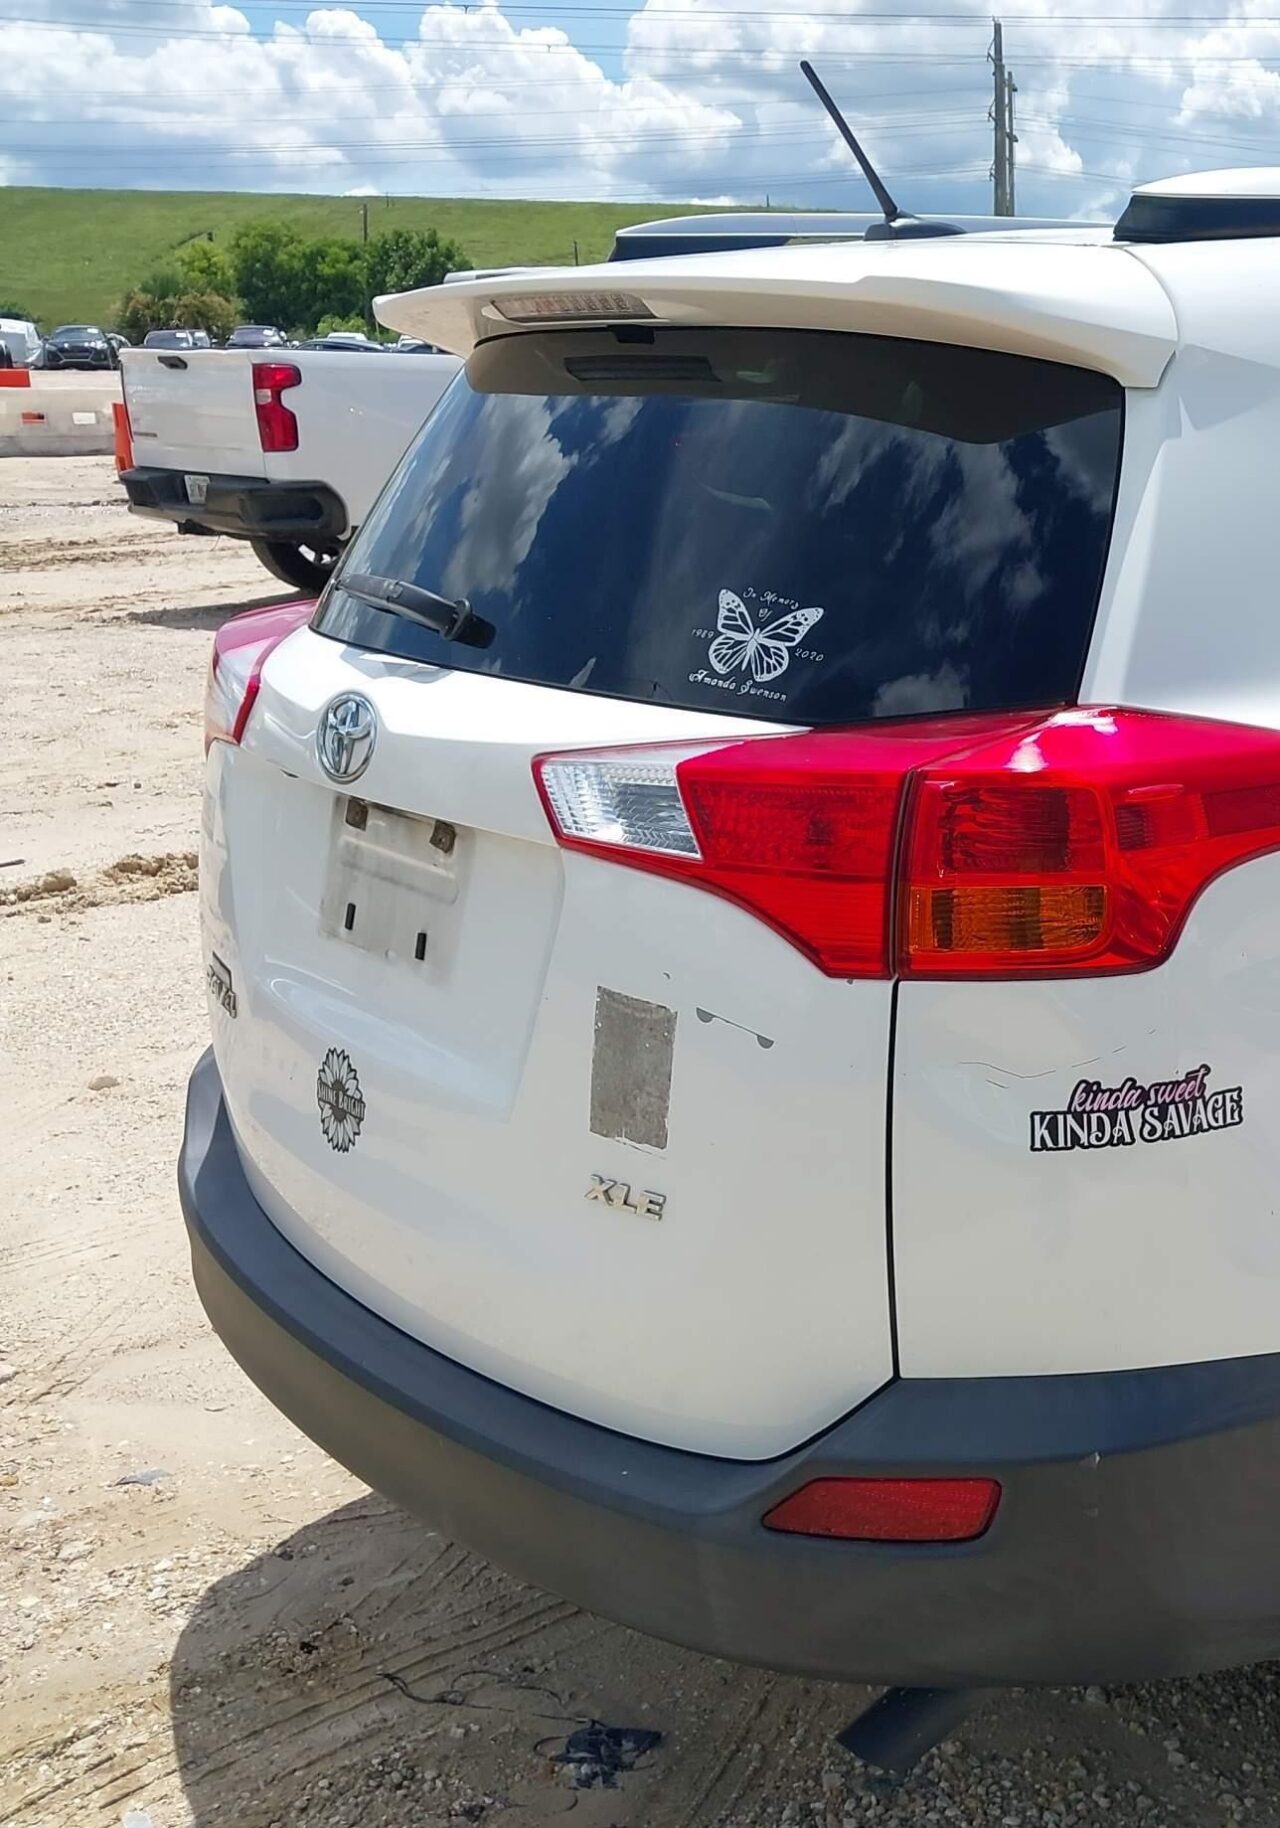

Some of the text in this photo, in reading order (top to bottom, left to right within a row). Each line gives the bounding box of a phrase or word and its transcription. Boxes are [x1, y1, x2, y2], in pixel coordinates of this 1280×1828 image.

[760, 590, 799, 609] Memory
[691, 628, 714, 639] 1989
[794, 648, 824, 662] 2020
[689, 669, 787, 702] Amanda Swenson
[1070, 1066, 1208, 1112] kinda sweet
[1033, 1090, 1242, 1150] KINDA SAVAGE
[584, 1174, 666, 1220] XLE
